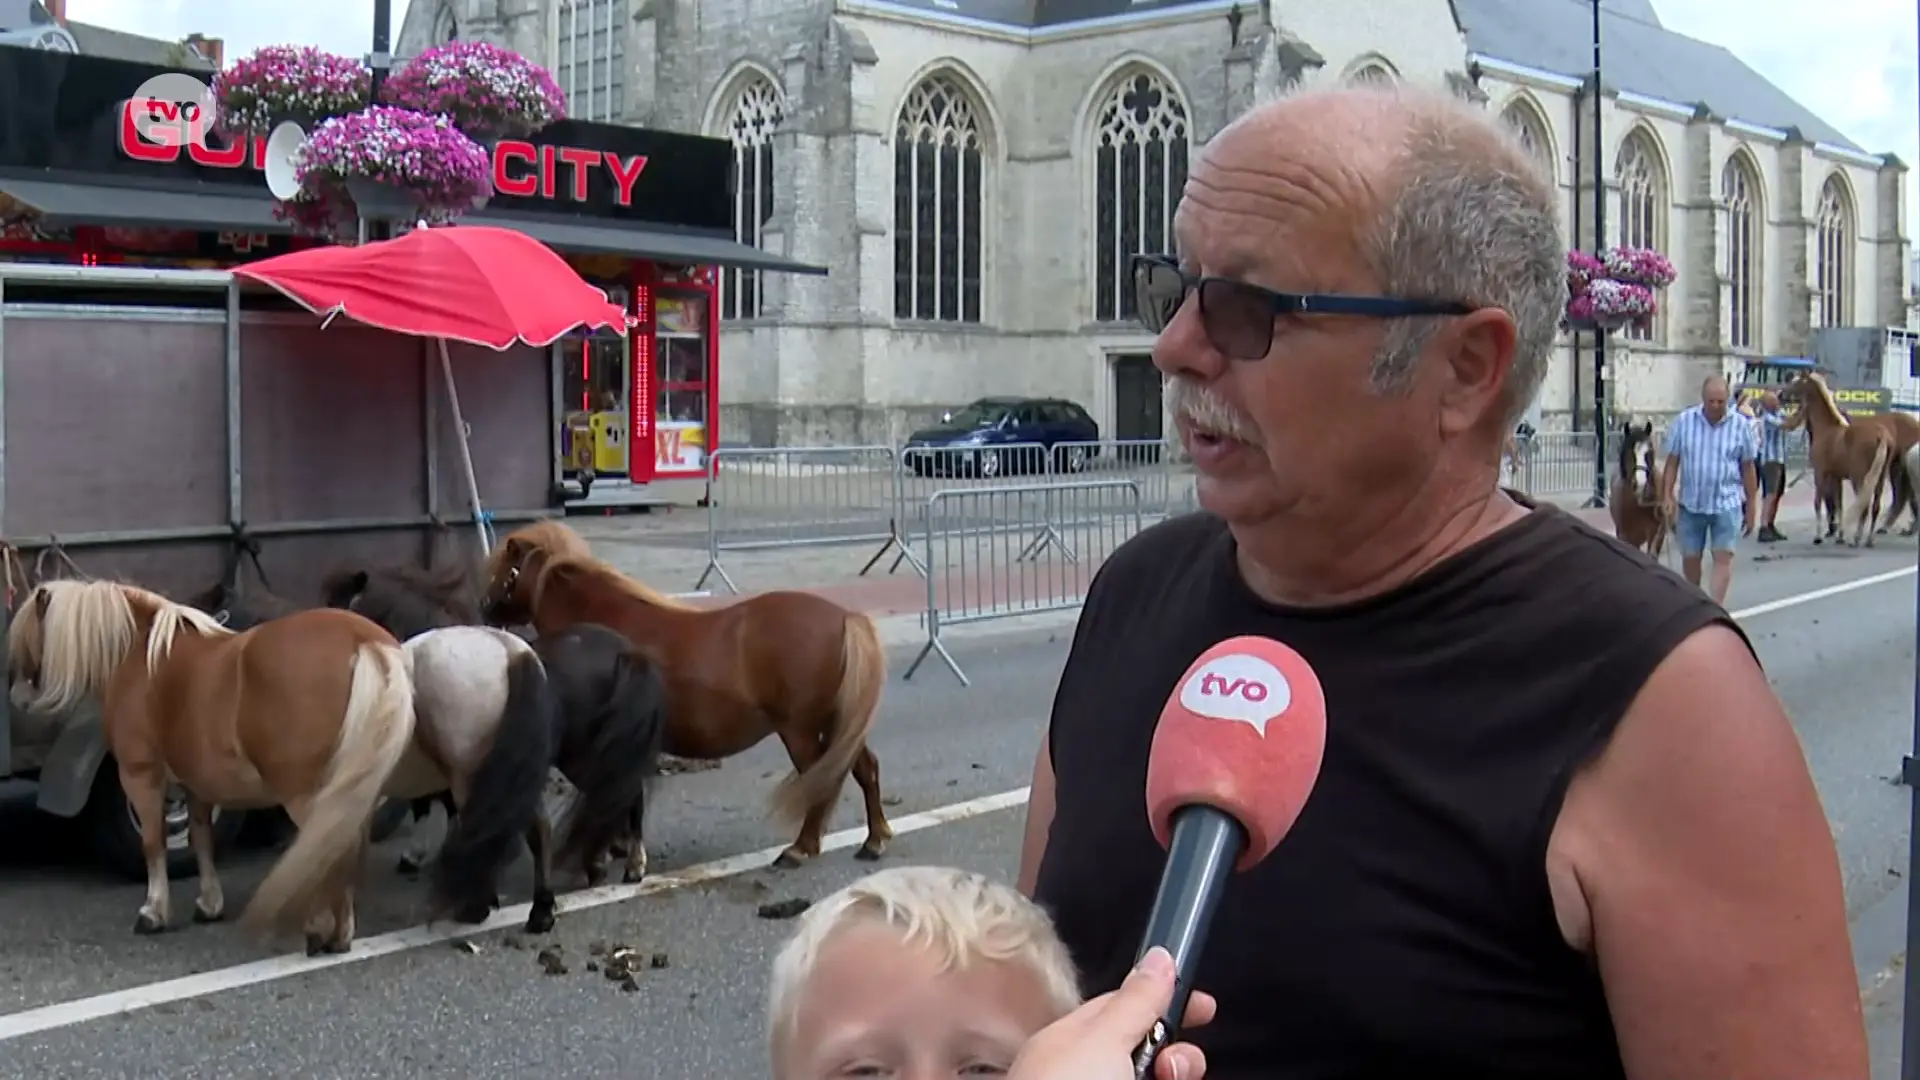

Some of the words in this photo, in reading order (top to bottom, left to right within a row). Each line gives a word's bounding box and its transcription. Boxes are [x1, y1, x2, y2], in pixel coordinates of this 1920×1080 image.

[493, 140, 648, 206] CITY
[1835, 389, 1881, 403] OCK
[1200, 671, 1268, 702] tvo
